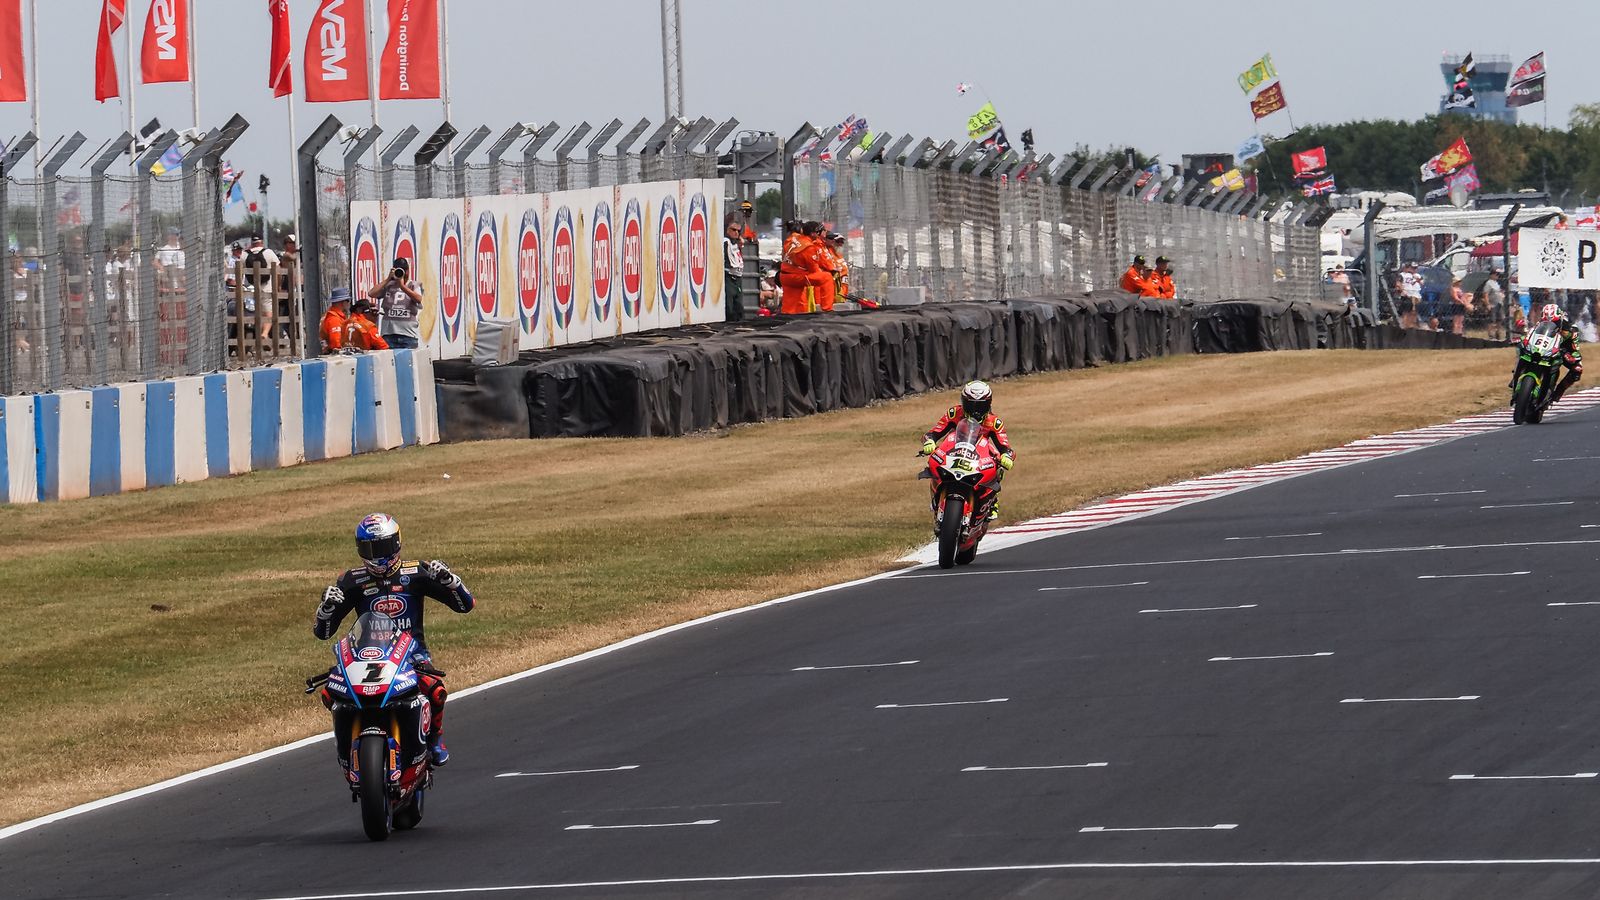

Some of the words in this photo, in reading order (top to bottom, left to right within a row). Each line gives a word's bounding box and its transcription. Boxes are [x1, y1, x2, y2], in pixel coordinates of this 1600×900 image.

[556, 244, 571, 287] PATA
[594, 239, 609, 281] PATA
[625, 235, 639, 276] PATA
[662, 232, 675, 272] PATA
[691, 229, 705, 269] PATA
[1577, 239, 1597, 279] P
[443, 254, 459, 299] PATA
[479, 251, 495, 295] PATA
[522, 248, 537, 291] PATA
[393, 291, 405, 305] P
[368, 617, 412, 631] YAMAHA
[377, 602, 399, 611] PATA
[327, 681, 348, 694] YAMAHA
[393, 678, 417, 692] YAMAHA
